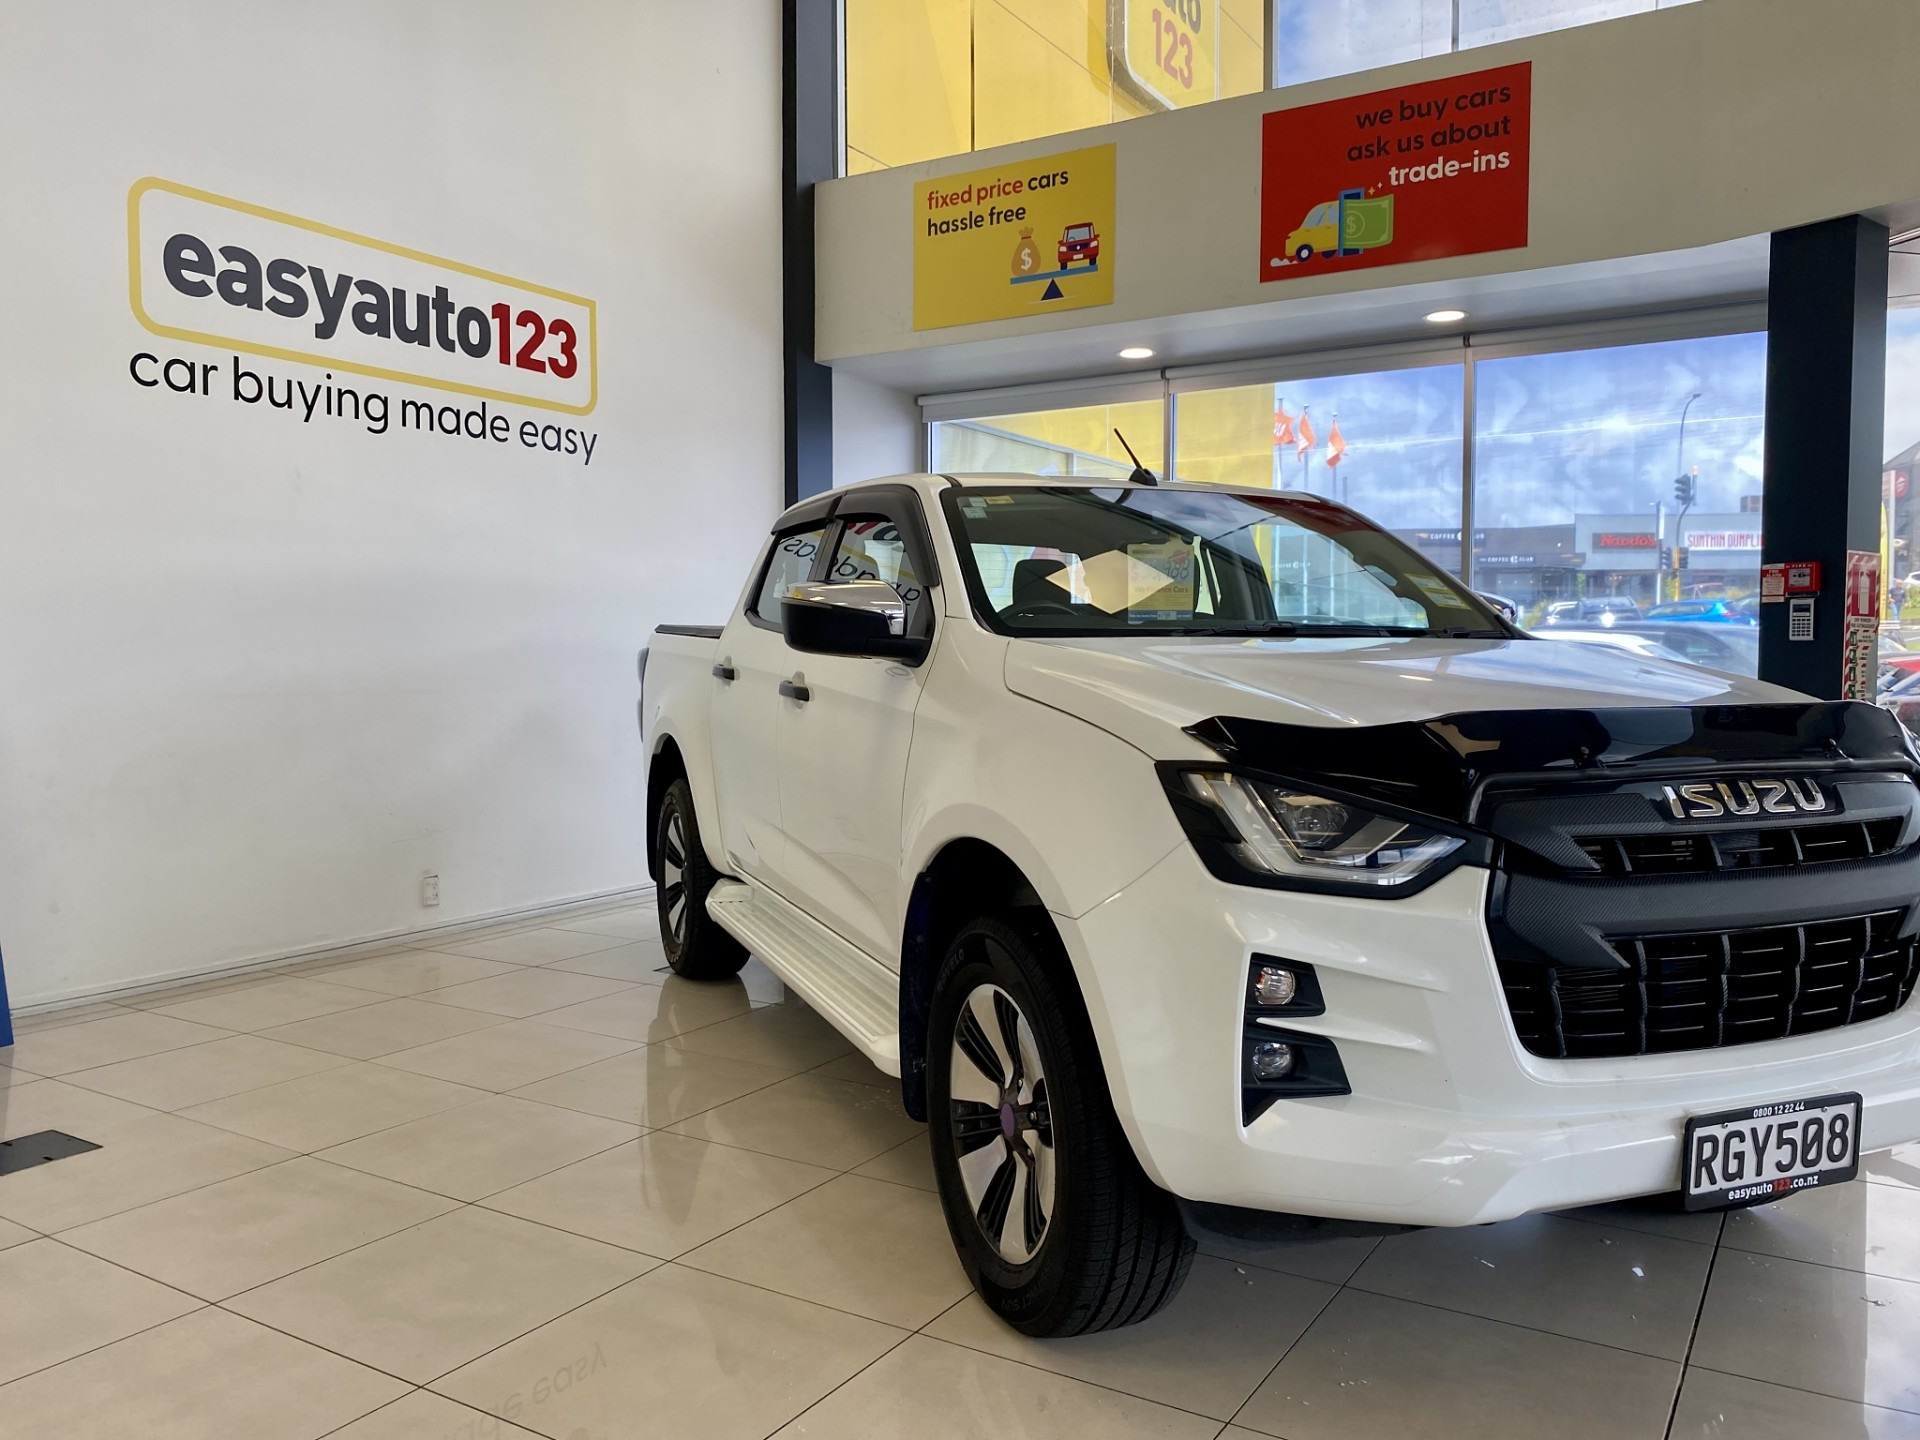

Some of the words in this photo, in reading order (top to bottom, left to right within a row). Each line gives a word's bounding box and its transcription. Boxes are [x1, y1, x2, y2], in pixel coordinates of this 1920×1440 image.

[1152, 8, 1193, 90] 123
[1356, 108, 1393, 129] we
[1400, 98, 1448, 122] buy
[1455, 86, 1511, 111] cars
[1347, 136, 1390, 161] ask
[1397, 134, 1425, 154] us
[1431, 116, 1511, 147] about
[1389, 150, 1510, 186] trade-ins
[927, 184, 972, 210] fixed
[977, 178, 1023, 206] price
[1028, 171, 1069, 191] cars
[927, 211, 984, 236] hassle
[989, 206, 1026, 226] free
[162, 232, 578, 380] easyauto123
[129, 352, 218, 396] car
[233, 356, 389, 434] buying
[400, 402, 511, 443] made
[518, 420, 598, 466] easy
[1687, 533, 1726, 548] SUMTHIN
[1661, 777, 1826, 819] ISUZU
[1753, 1107, 1772, 1118] 0800
[1774, 1106, 1783, 1115] 12
[1784, 1104, 1794, 1113] 22
[1794, 1102, 1805, 1112] 44
[1694, 1113, 1850, 1189] RGY508
[1728, 1174, 1819, 1200] easyauto123.co.nz
